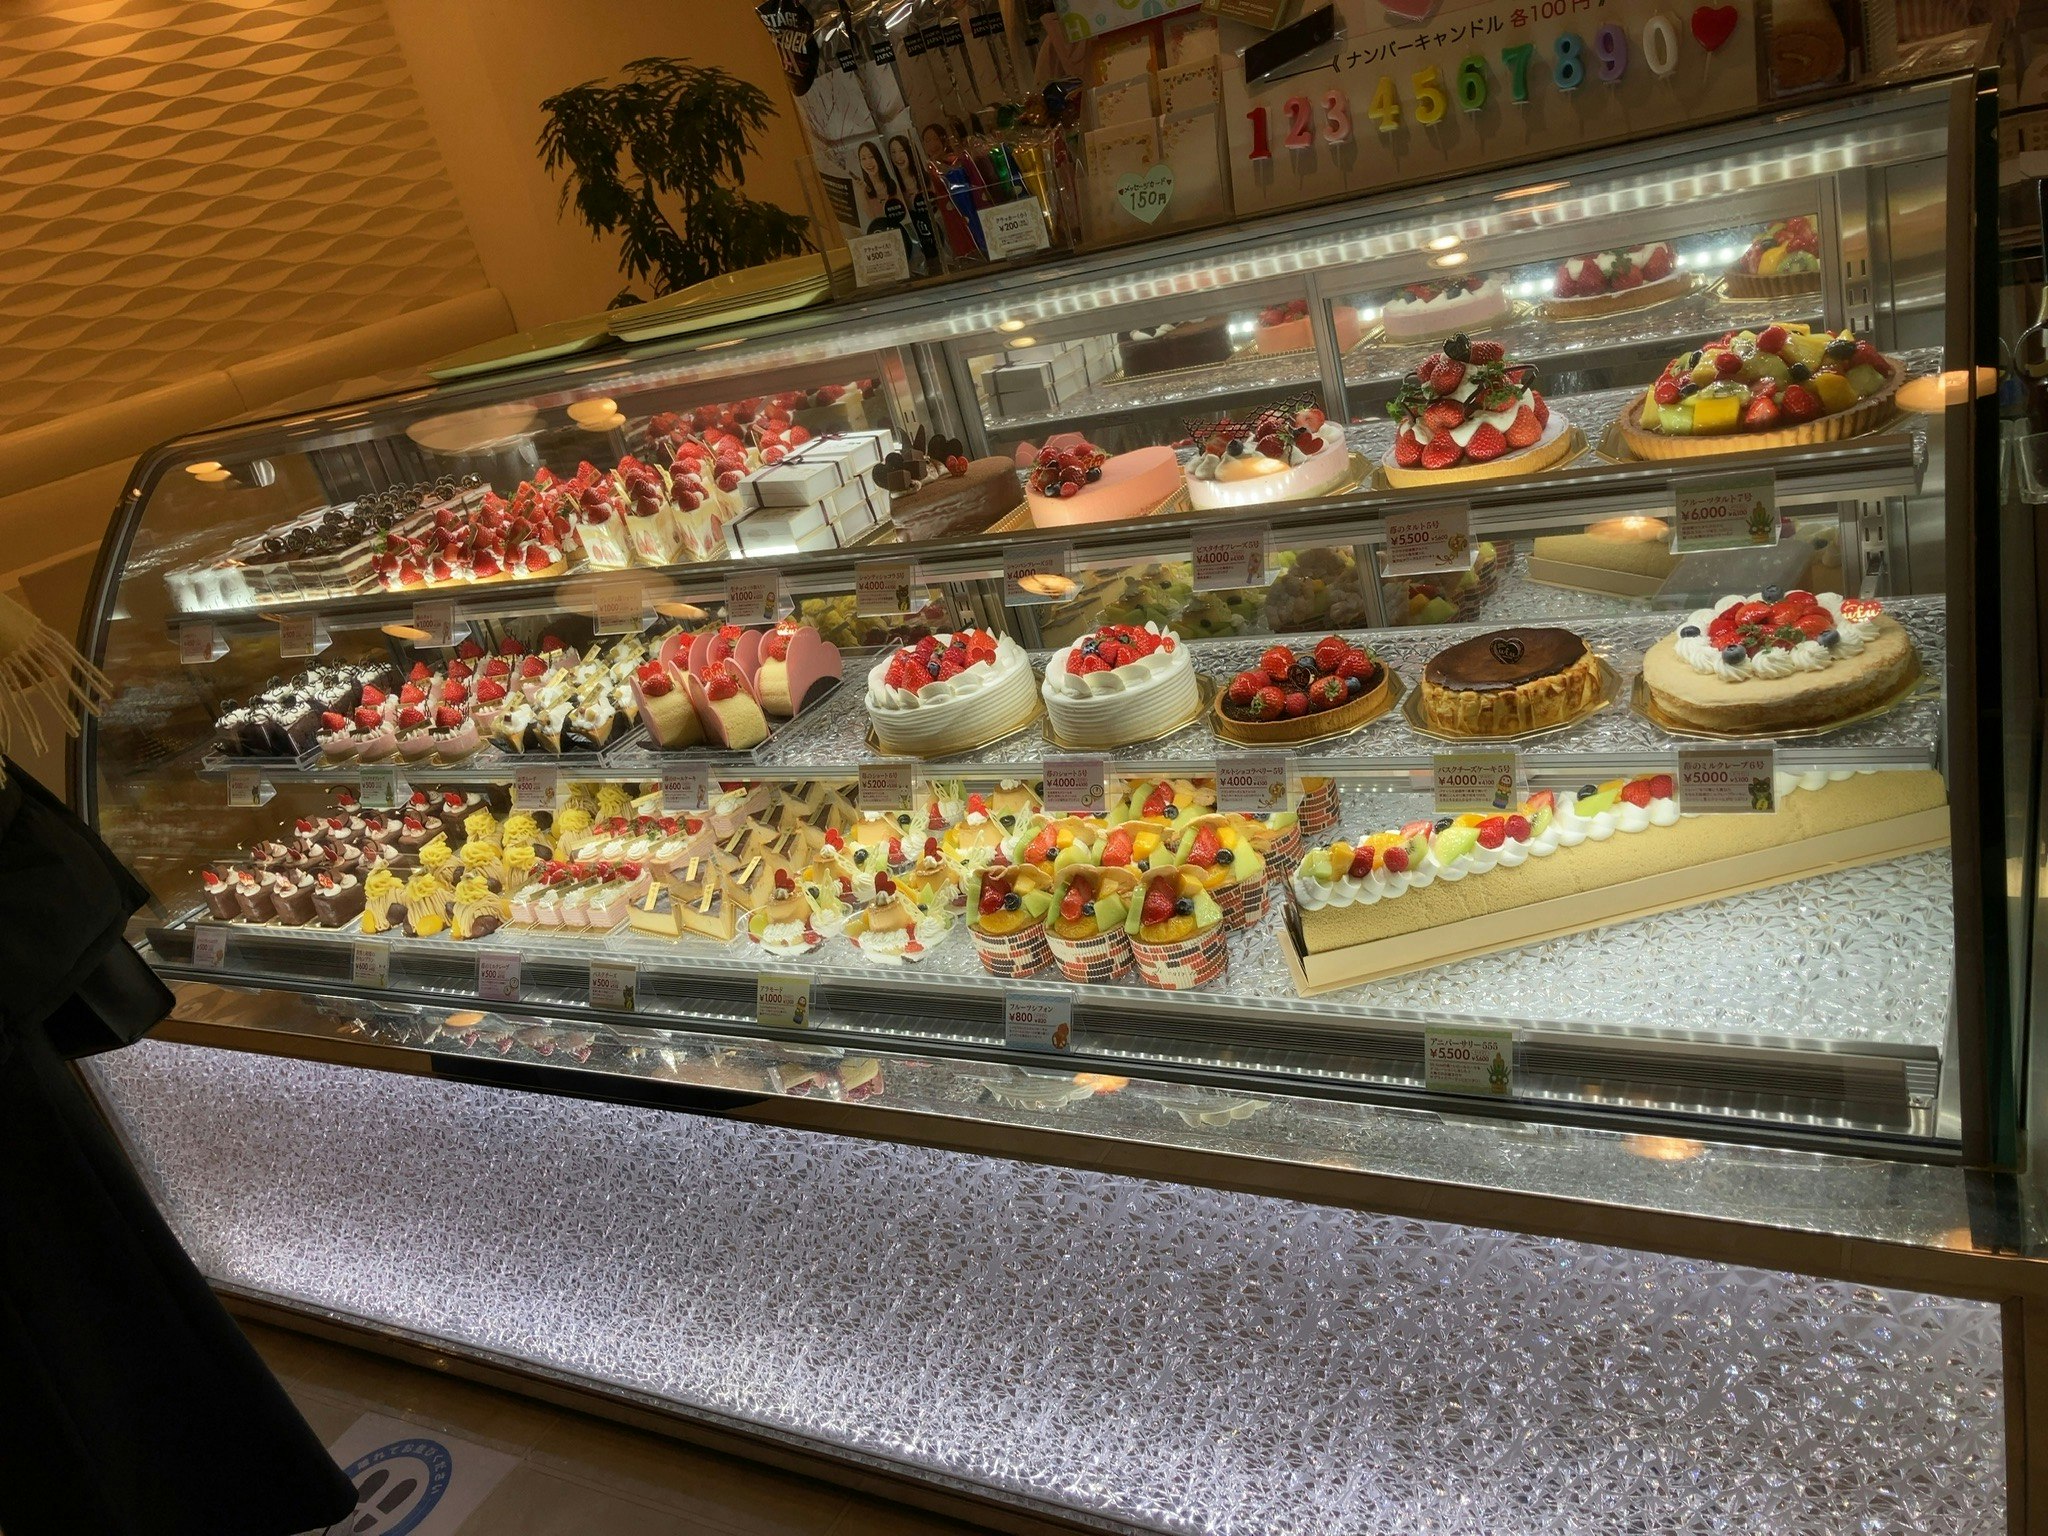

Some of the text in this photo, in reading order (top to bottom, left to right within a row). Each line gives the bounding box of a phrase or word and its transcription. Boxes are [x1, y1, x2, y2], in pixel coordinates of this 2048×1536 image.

[761, 12, 798, 28] STAGE
[1347, 0, 1590, 68] ナンバーキャンドル 各100円
[876, 52, 893, 61] JAPAN
[1247, 15, 1677, 159] 1 2 3 4 5 6 7 8 9 0
[1131, 191, 1166, 210] 150円
[999, 222, 1018, 232] ¥200
[866, 252, 883, 261] ¥500
[1681, 506, 1726, 521] ¥6,000
[1391, 532, 1429, 545] ¥5,500
[1197, 552, 1229, 564] ¥4,000
[1438, 765, 1511, 774] バスクチーズケーキ5号
[1684, 761, 1765, 770] 苺のミルクレープ6号
[1220, 776, 1252, 786] ¥4,000
[1438, 775, 1477, 785] ¥4,000
[1683, 771, 1728, 783] ¥5,000
[664, 782, 681, 790] ¥600
[1047, 778, 1075, 787] ¥4,000
[481, 970, 497, 978] ¥500
[592, 980, 609, 988] ¥500
[1010, 1004, 1053, 1012] フルーツシフォン
[1009, 1012, 1033, 1022] ¥800
[1430, 1048, 1470, 1060] ¥5,500
